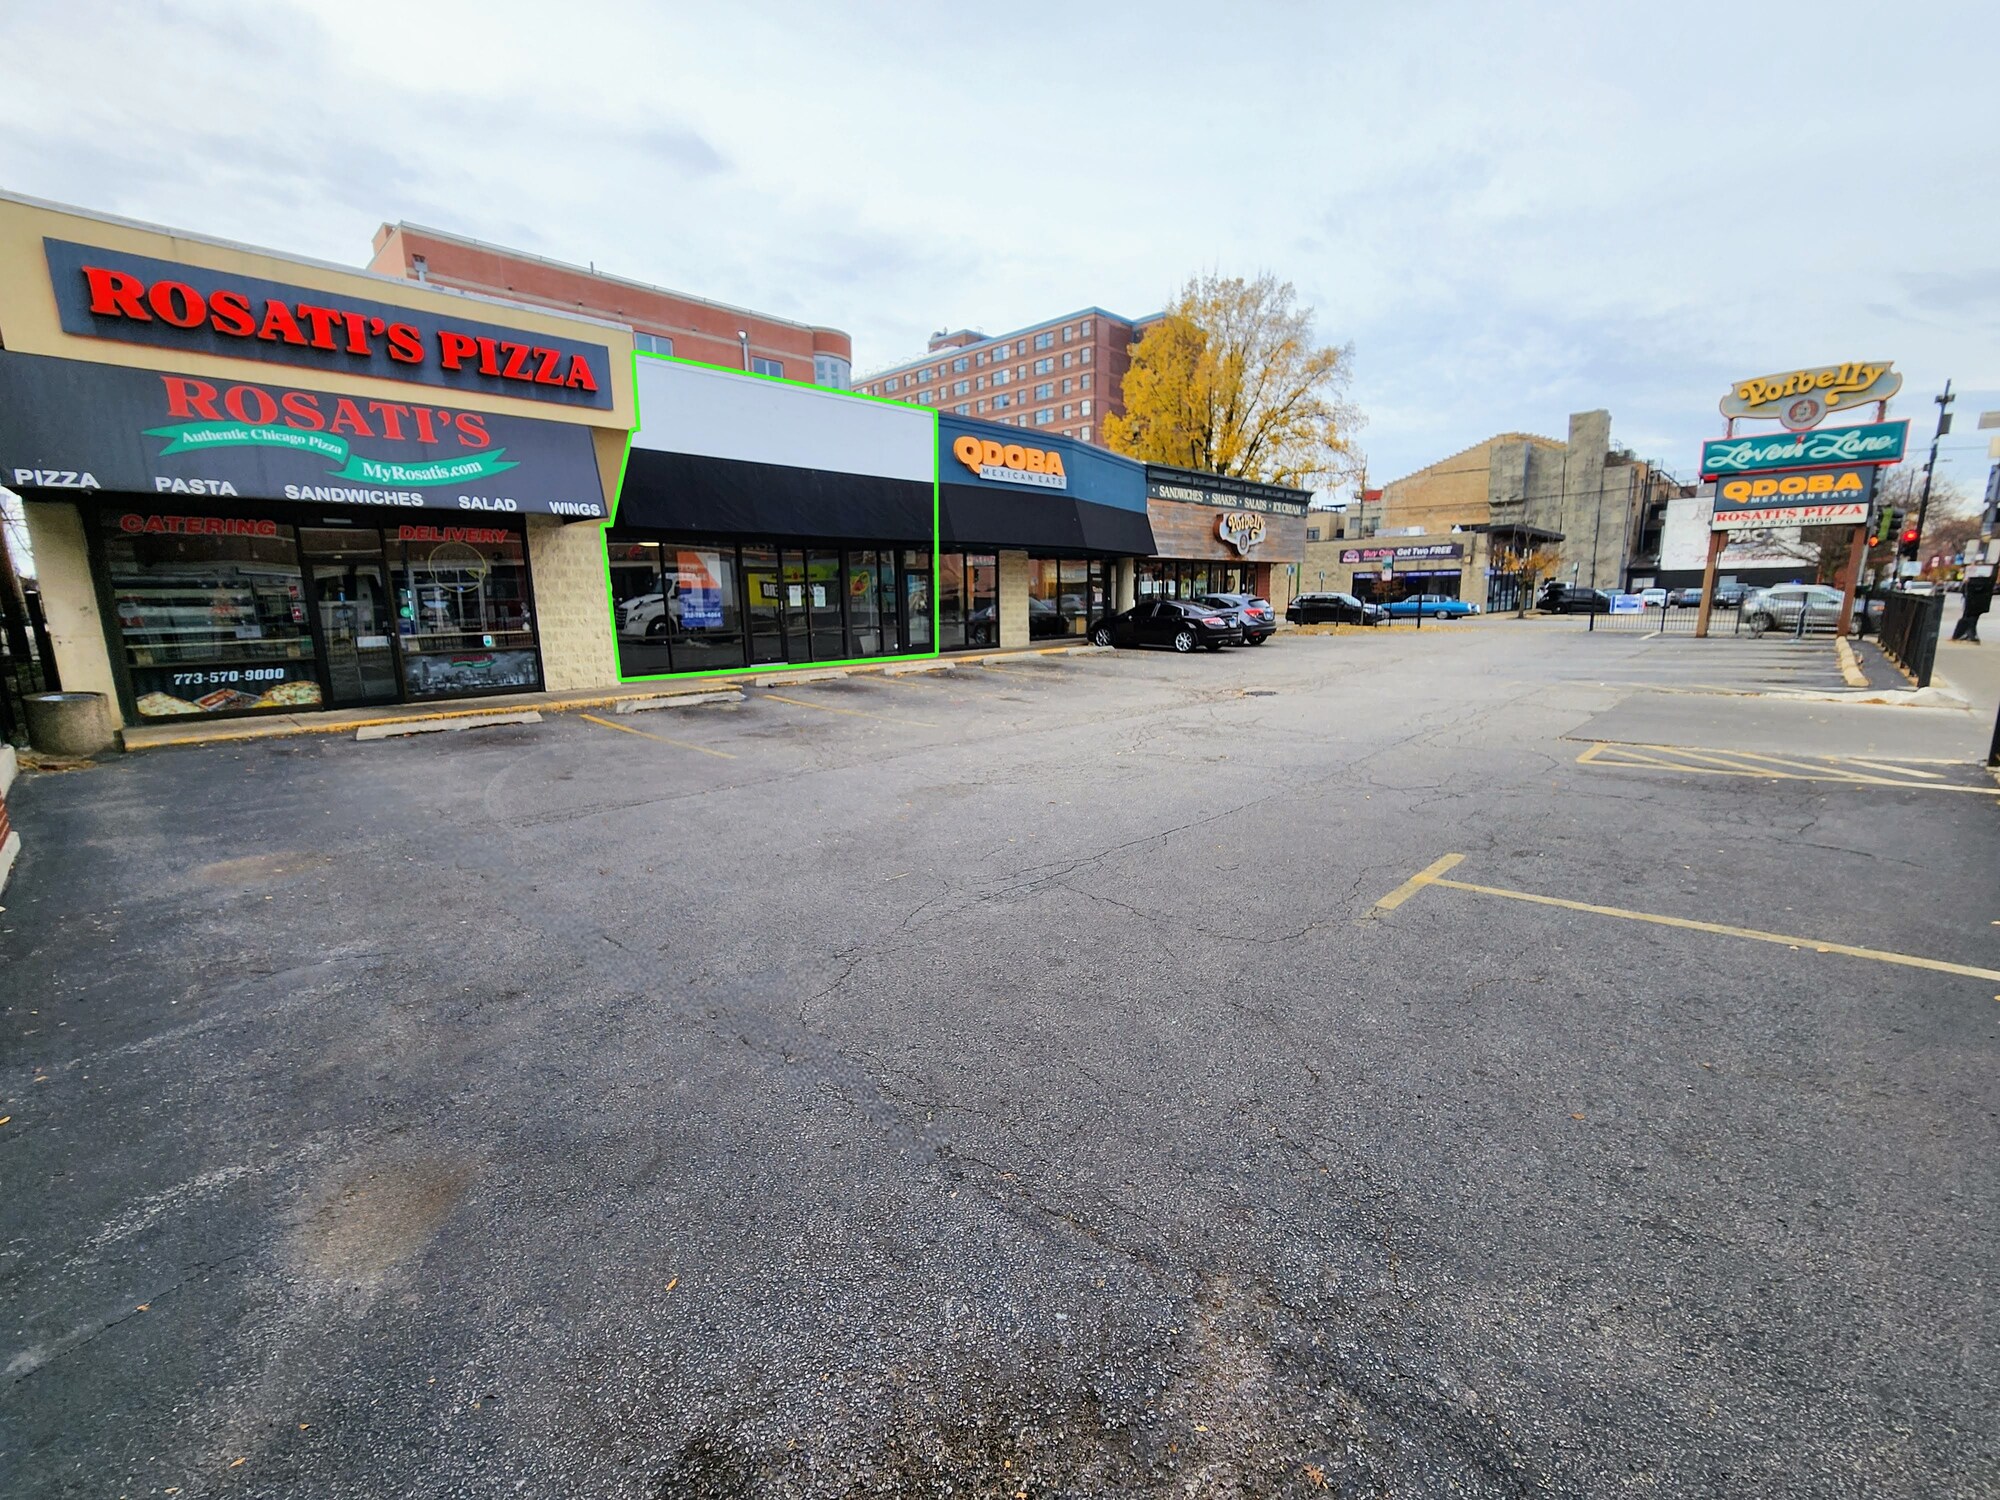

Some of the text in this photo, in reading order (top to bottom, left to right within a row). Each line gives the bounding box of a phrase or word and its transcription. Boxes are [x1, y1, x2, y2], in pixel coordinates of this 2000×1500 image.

[82, 265, 599, 392] ROSATI'S PIZZA
[1738, 361, 1885, 406] Potbelly
[160, 375, 491, 449] ROSATI'S
[183, 428, 342, 455] Authentic Chicago Pizza
[1809, 430, 1897, 459] Lane
[953, 436, 1065, 476] QDOBA
[362, 462, 483, 482] MyRosatis.com
[982, 467, 1063, 487] MEXICAN EATS
[14, 467, 601, 517] PIZZA PASTA SANDWICHES SALAD WINGS
[1159, 485, 1301, 514] SANDWICHES SHAKES SALADS ICE CREAM
[1723, 472, 1863, 503] QDOBA
[1750, 489, 1858, 504] MEXICAN EATS
[120, 514, 277, 536] CATERING
[1228, 512, 1266, 540] Potbelly
[1716, 507, 1797, 522] ROSATI'S
[1804, 504, 1863, 517] PIZZA
[399, 525, 508, 543] DELIVERY
[1397, 548, 1411, 556] Get
[1412, 547, 1429, 556] Two
[1429, 545, 1452, 555] FREE
[173, 667, 285, 686] 773-570-9000
